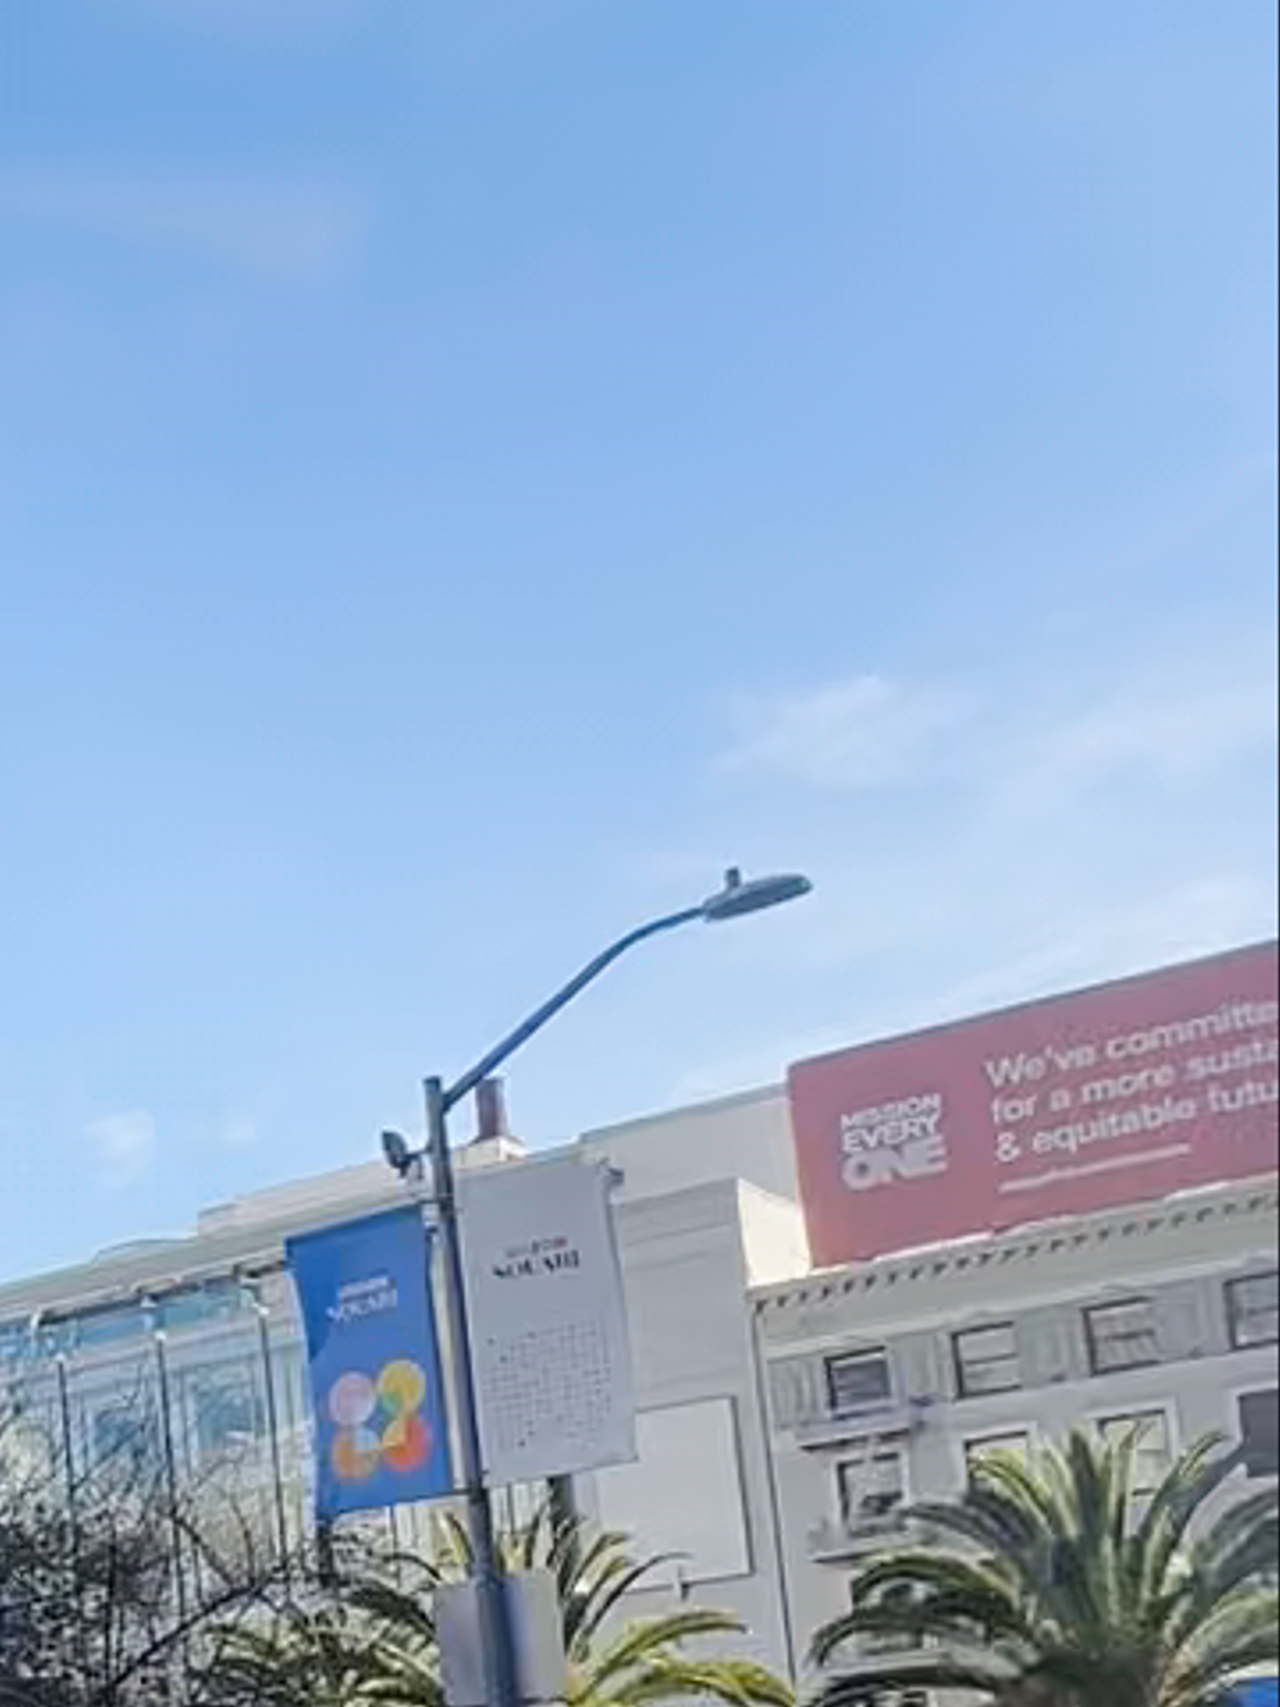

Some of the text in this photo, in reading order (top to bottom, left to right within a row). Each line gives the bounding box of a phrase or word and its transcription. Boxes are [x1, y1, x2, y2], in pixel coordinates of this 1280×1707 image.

[986, 1046, 1095, 1087] We've
[992, 1095, 1037, 1124] for
[1050, 1091, 1070, 1110] a
[1082, 1065, 1175, 1102] more
[844, 1112, 940, 1151] EVERY
[996, 1133, 1021, 1162] &
[1032, 1097, 1197, 1153] equitable
[842, 1132, 947, 1190] ONE
